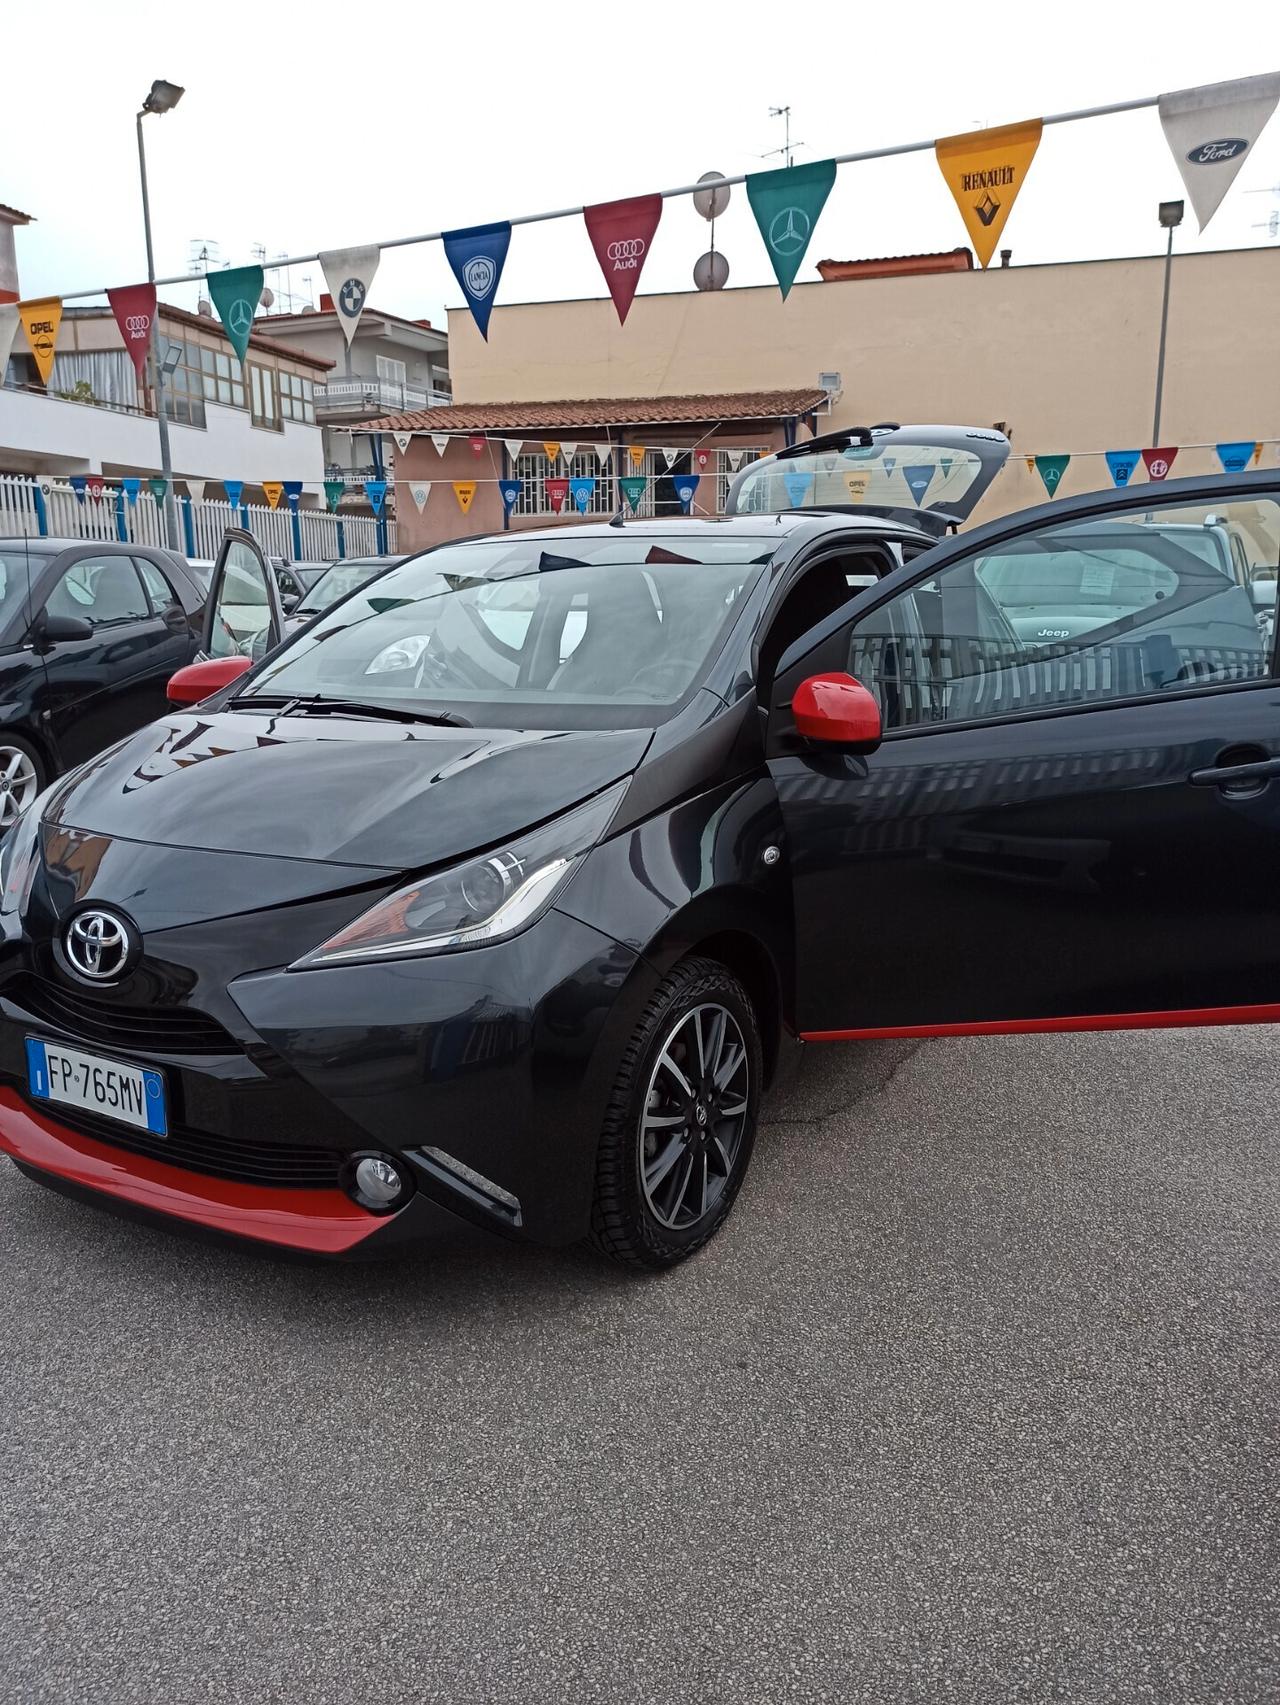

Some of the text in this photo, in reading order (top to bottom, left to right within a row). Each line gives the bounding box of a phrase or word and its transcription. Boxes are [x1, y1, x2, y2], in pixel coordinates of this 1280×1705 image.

[1199, 142, 1237, 162] Ford
[961, 166, 1015, 192] RENAULT
[613, 258, 637, 271] Audi
[30, 321, 54, 335] OPEL
[1038, 628, 1070, 638] Jeep
